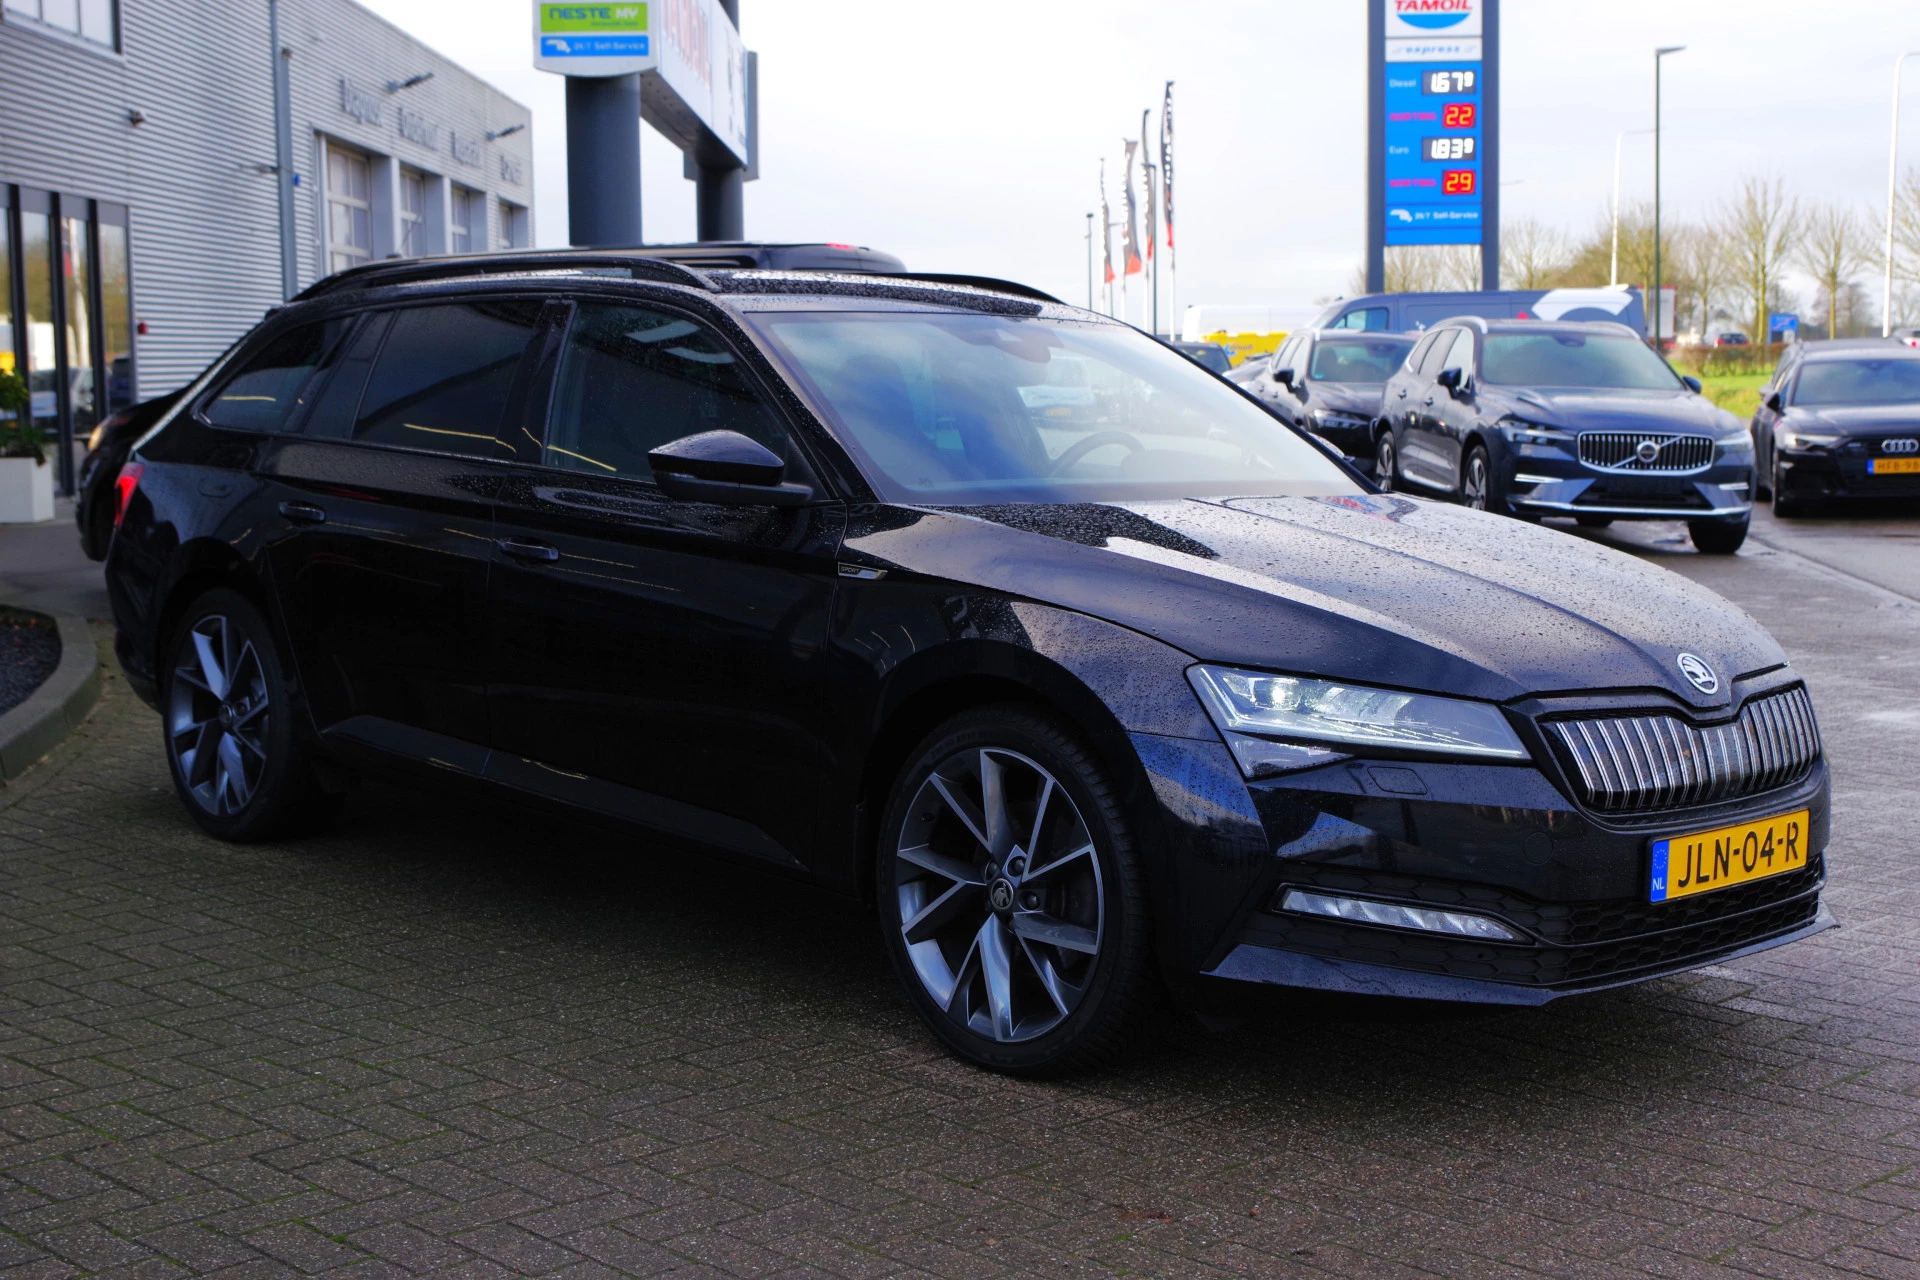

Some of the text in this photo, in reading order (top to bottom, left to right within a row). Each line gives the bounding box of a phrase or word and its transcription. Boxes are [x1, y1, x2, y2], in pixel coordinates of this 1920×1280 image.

[1395, 0, 1472, 11] TAMOIL
[616, 7, 638, 19] MY
[1389, 78, 1416, 88] Diesel
[1446, 106, 1472, 125] 22
[1389, 145, 1409, 154] Euro
[1446, 172, 1472, 191] 29
[1677, 821, 1799, 888] JLN-04-R
[1652, 877, 1665, 891] NL
